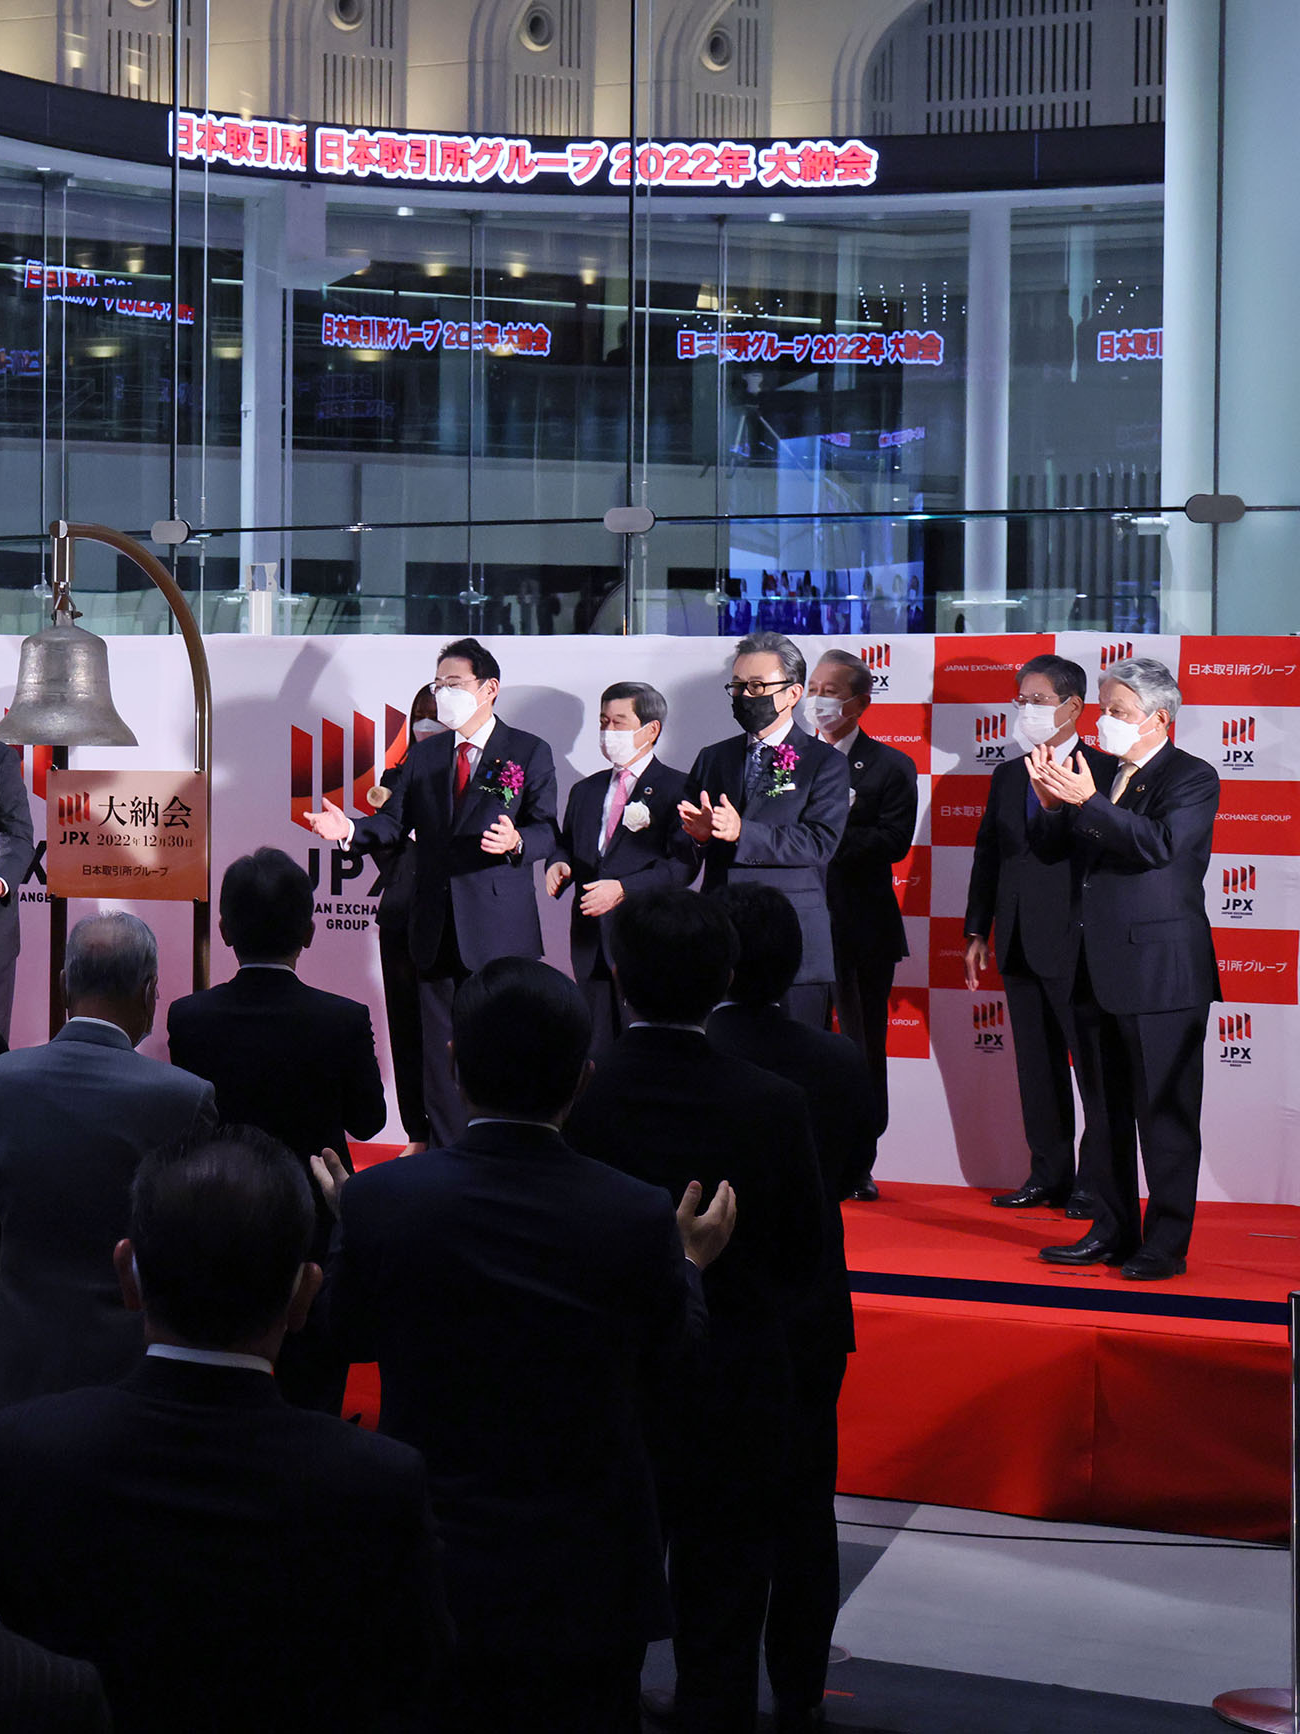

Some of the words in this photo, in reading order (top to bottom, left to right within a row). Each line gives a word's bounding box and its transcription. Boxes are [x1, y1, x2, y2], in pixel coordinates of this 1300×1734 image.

[171, 113, 306, 171] 日本取引所
[317, 130, 605, 183] 日本取引所グループ
[612, 145, 753, 184] 2022年
[760, 143, 877, 184] 大納会
[323, 314, 441, 350] 日本取引所グループ
[812, 333, 887, 365] 2022年
[944, 664, 969, 672] JAPAN
[971, 663, 1013, 671] EXCHANGE
[1188, 663, 1297, 676] 日本取引所グループ
[872, 675, 889, 687] PX
[975, 746, 1005, 759] JPX
[1222, 750, 1254, 763] JPX
[98, 795, 192, 829] 大納会
[1260, 814, 1292, 822] GROUP
[59, 831, 89, 845] JPX
[82, 864, 169, 877] 日本取引所グループ
[336, 904, 379, 915] EXCHA
[1221, 898, 1254, 911] JPX
[326, 919, 370, 931] GROUP
[892, 1018, 920, 1026] GROUP
[974, 1033, 1004, 1046] JPX
[1220, 1046, 1252, 1060] JPX
